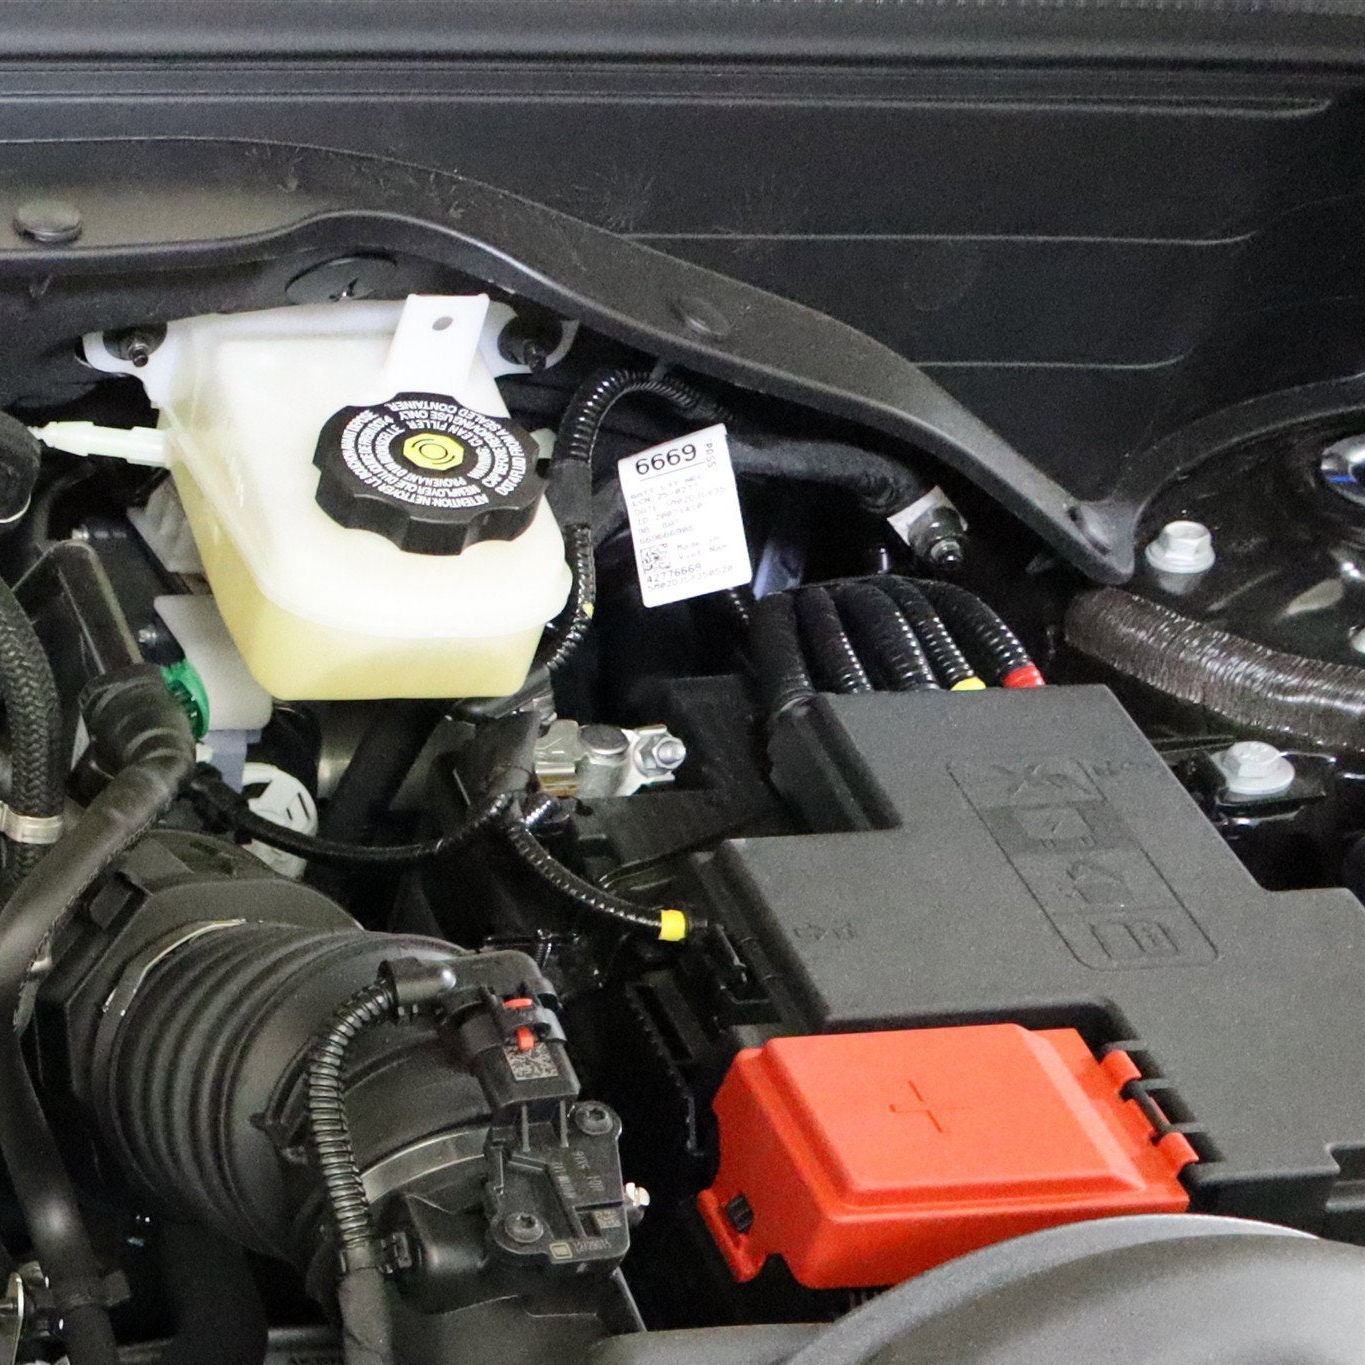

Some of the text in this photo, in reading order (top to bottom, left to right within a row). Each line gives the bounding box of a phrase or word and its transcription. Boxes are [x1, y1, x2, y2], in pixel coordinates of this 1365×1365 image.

[396, 410, 427, 420] ONLY
[405, 420, 447, 430] FILLER
[430, 411, 453, 422] USE
[458, 407, 503, 430] SEALED
[447, 424, 484, 445] CLEAN
[635, 443, 697, 476] 6669
[376, 483, 429, 505] NETTOYER
